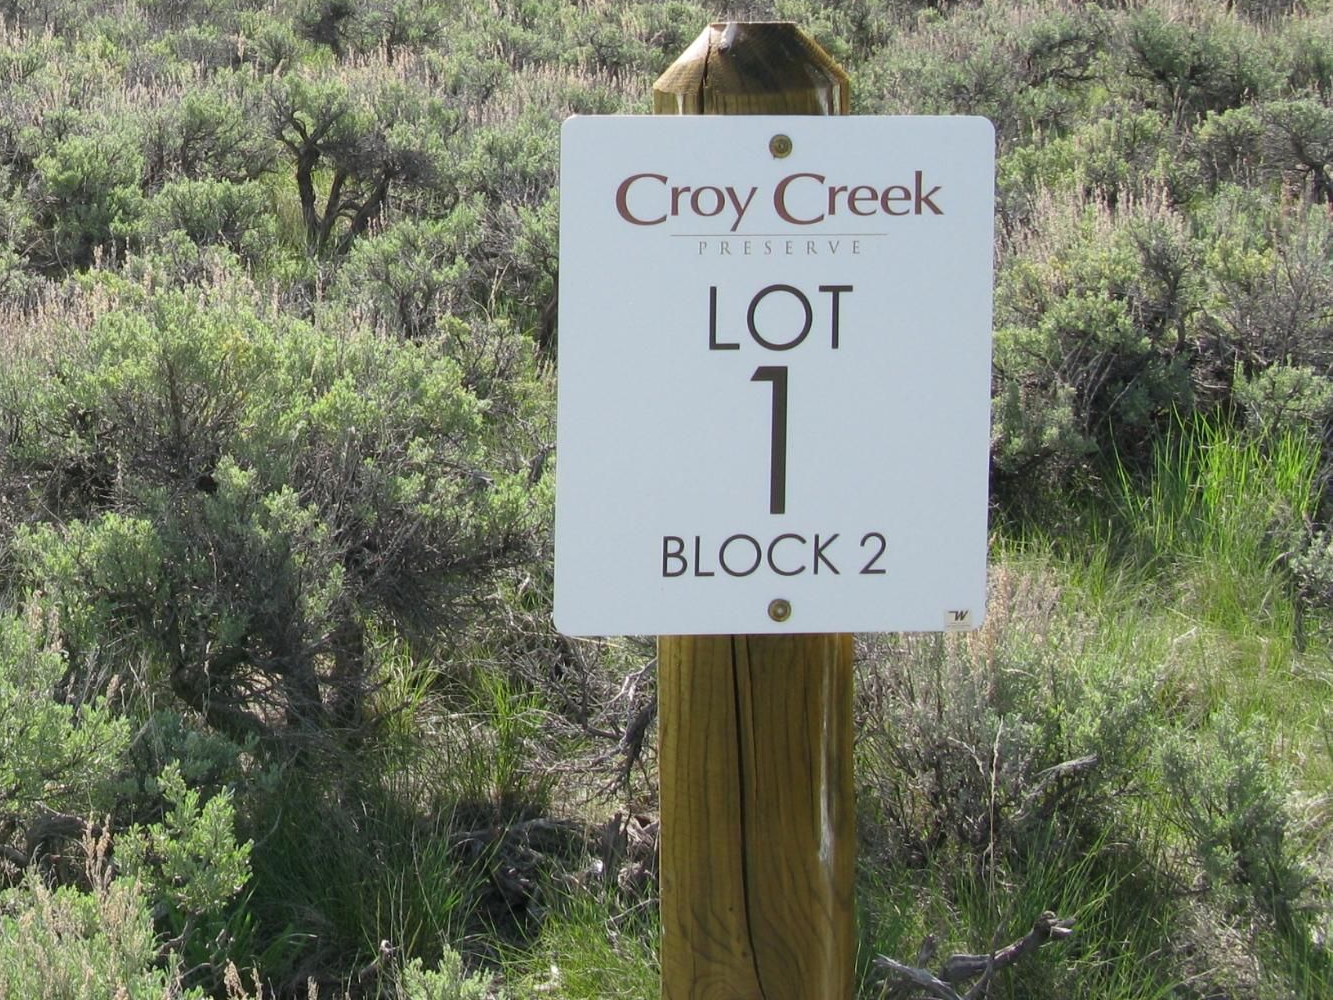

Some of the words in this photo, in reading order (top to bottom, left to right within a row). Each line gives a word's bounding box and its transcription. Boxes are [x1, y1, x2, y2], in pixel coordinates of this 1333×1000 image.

[616, 173, 758, 232] Croy
[773, 170, 944, 225] Creek
[698, 239, 861, 256] PRESERVE
[709, 284, 854, 351] LOT
[750, 366, 788, 515] 1
[662, 533, 840, 577] BLOCK
[860, 532, 887, 574] 2
